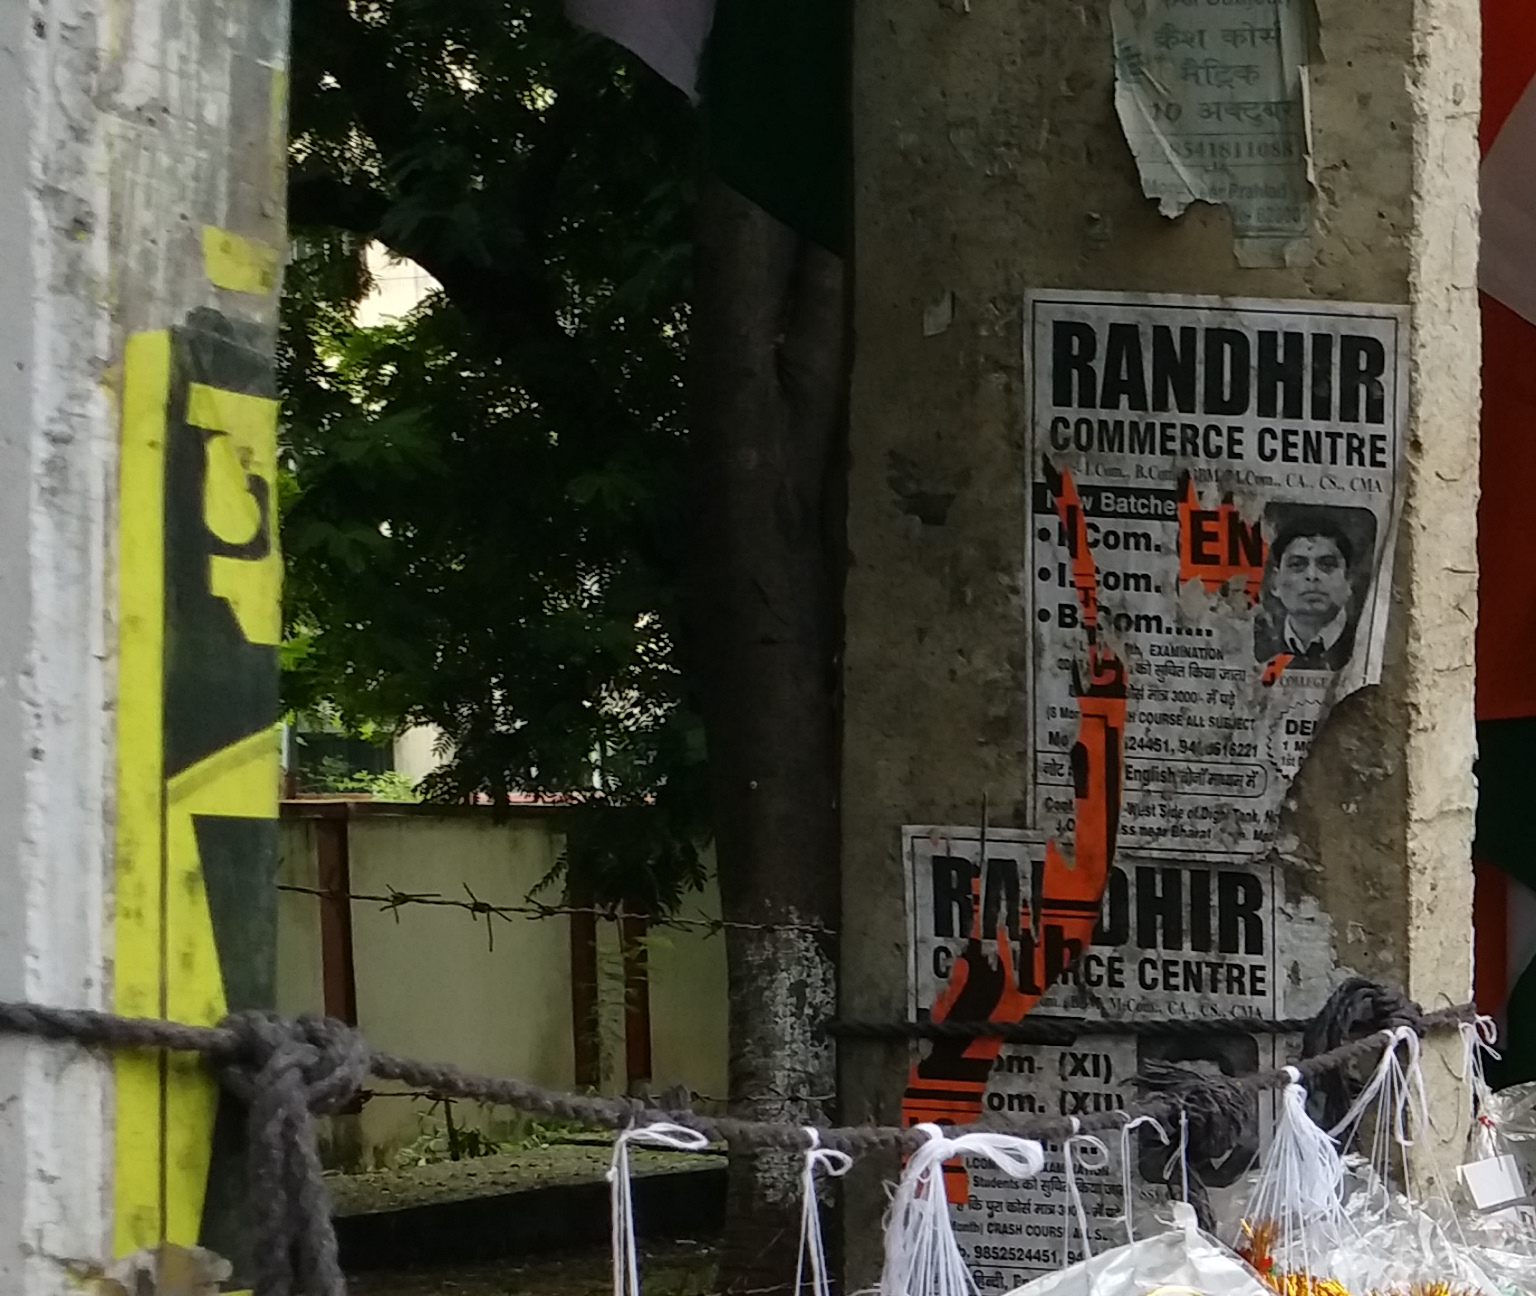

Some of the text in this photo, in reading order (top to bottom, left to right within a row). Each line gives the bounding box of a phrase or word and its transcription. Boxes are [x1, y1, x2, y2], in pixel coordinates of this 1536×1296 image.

[1051, 320, 1385, 425] RANDHIR
[1050, 416, 1387, 469] COMMERCE CENTRE
[1138, 713, 1184, 728] COURSE
[1126, 765, 1176, 785] English
[1138, 958, 1267, 997] CENTRE
[986, 1222, 1023, 1236] CRASH
[1026, 1224, 1065, 1239] COURS
